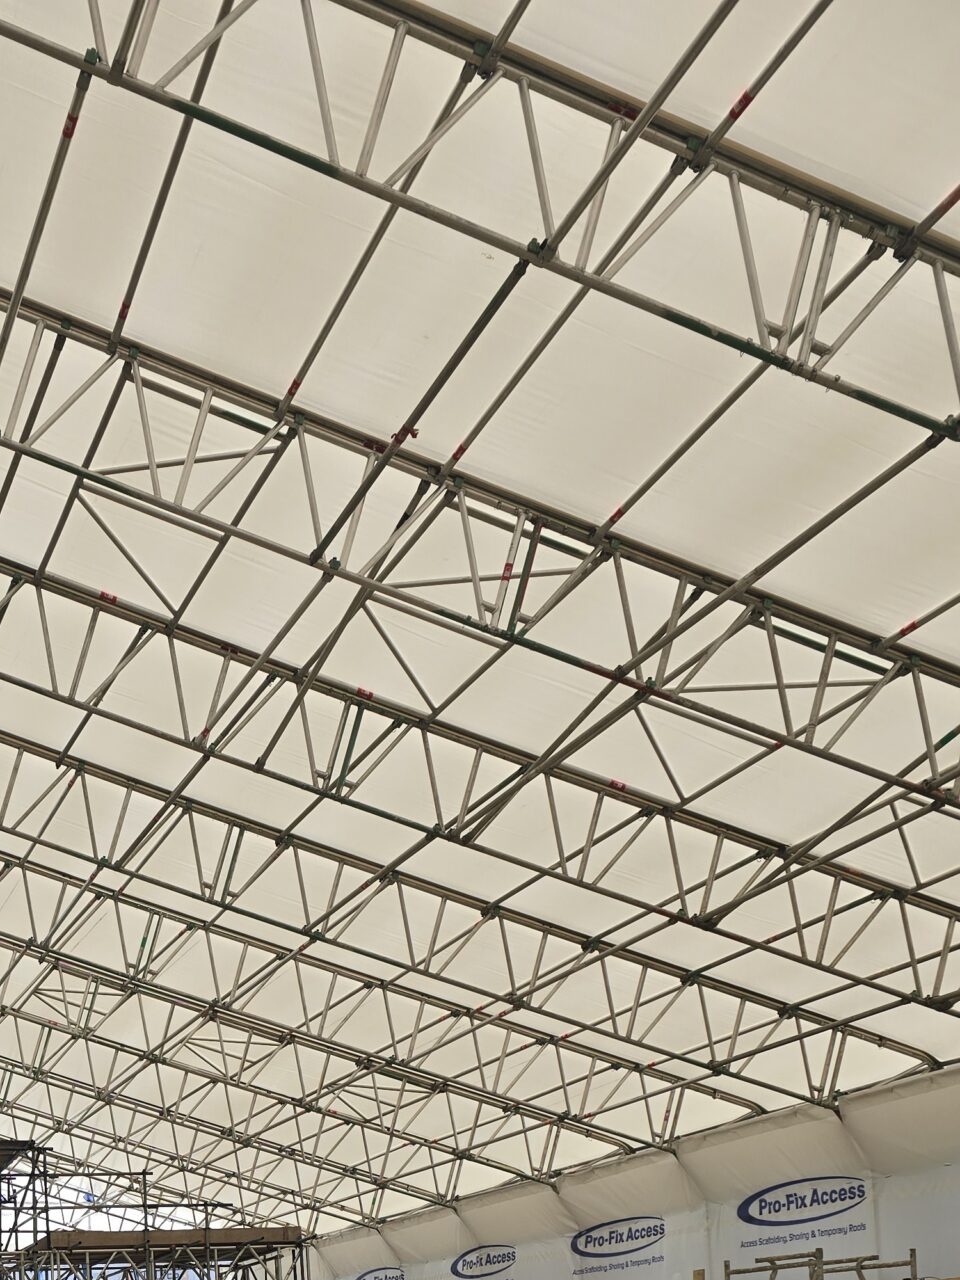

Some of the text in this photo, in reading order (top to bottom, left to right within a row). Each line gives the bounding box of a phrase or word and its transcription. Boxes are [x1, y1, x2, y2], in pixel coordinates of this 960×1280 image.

[758, 1184, 866, 1216] Pro-Fix Access
[584, 1223, 665, 1248] Pro-Fix Access
[810, 1230, 816, 1238] &
[485, 1251, 516, 1266] Access
